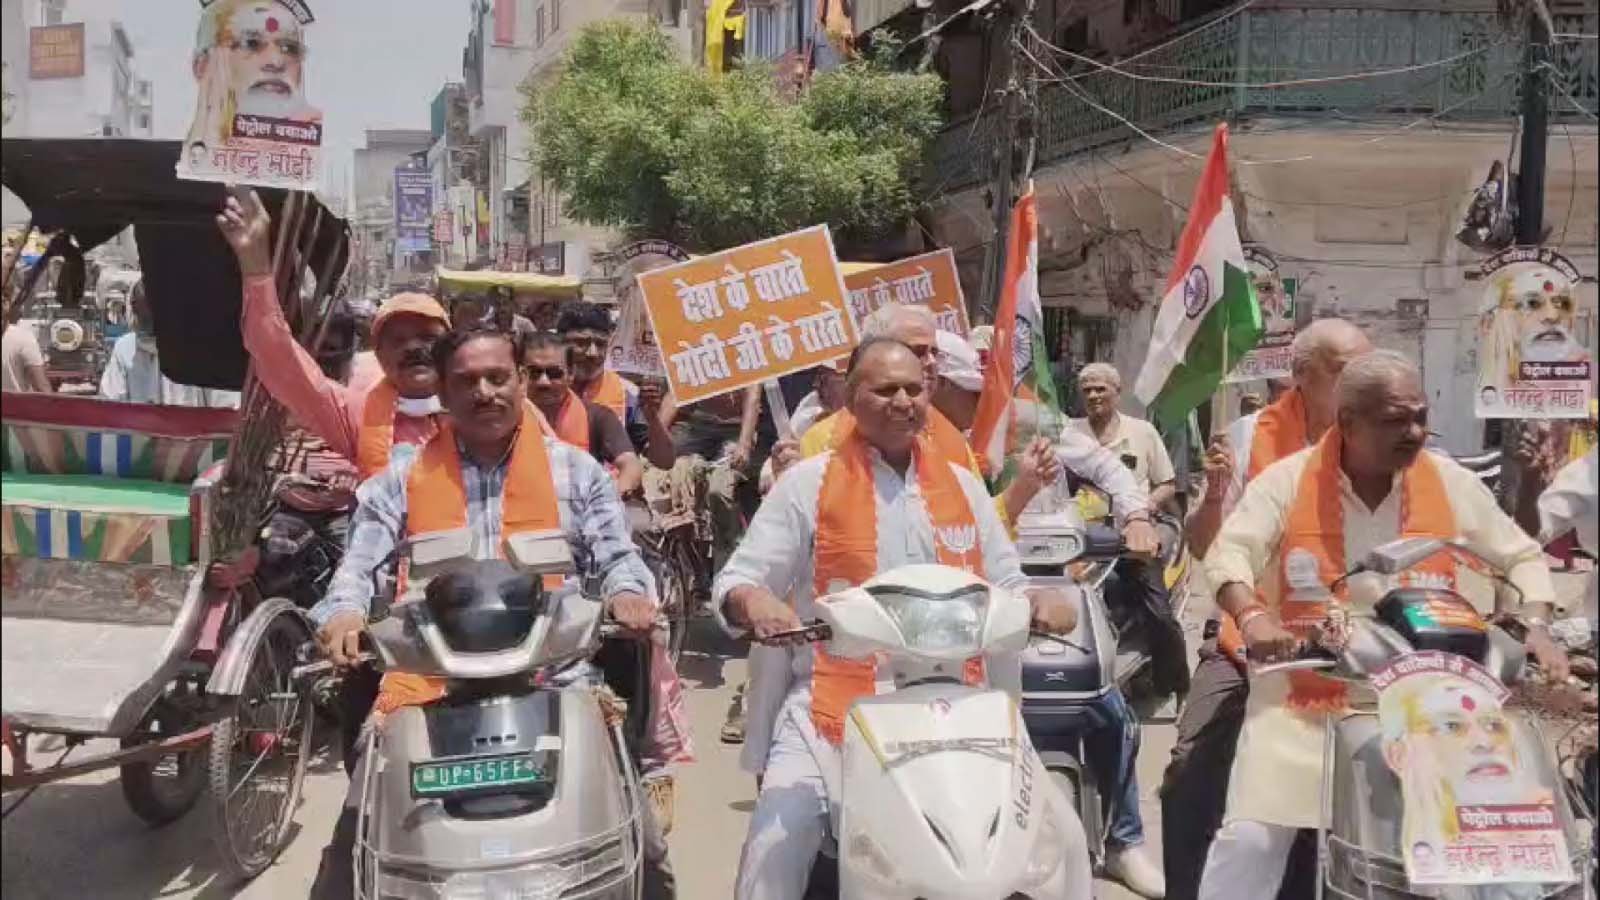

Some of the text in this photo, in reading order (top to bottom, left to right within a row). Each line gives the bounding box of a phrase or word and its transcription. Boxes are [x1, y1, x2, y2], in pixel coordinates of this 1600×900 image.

[673, 249, 810, 323] देश के वास्ते
[669, 332, 732, 386] मोदी
[726, 321, 768, 371] जी
[763, 315, 794, 360] के
[793, 301, 847, 352] रास्ते
